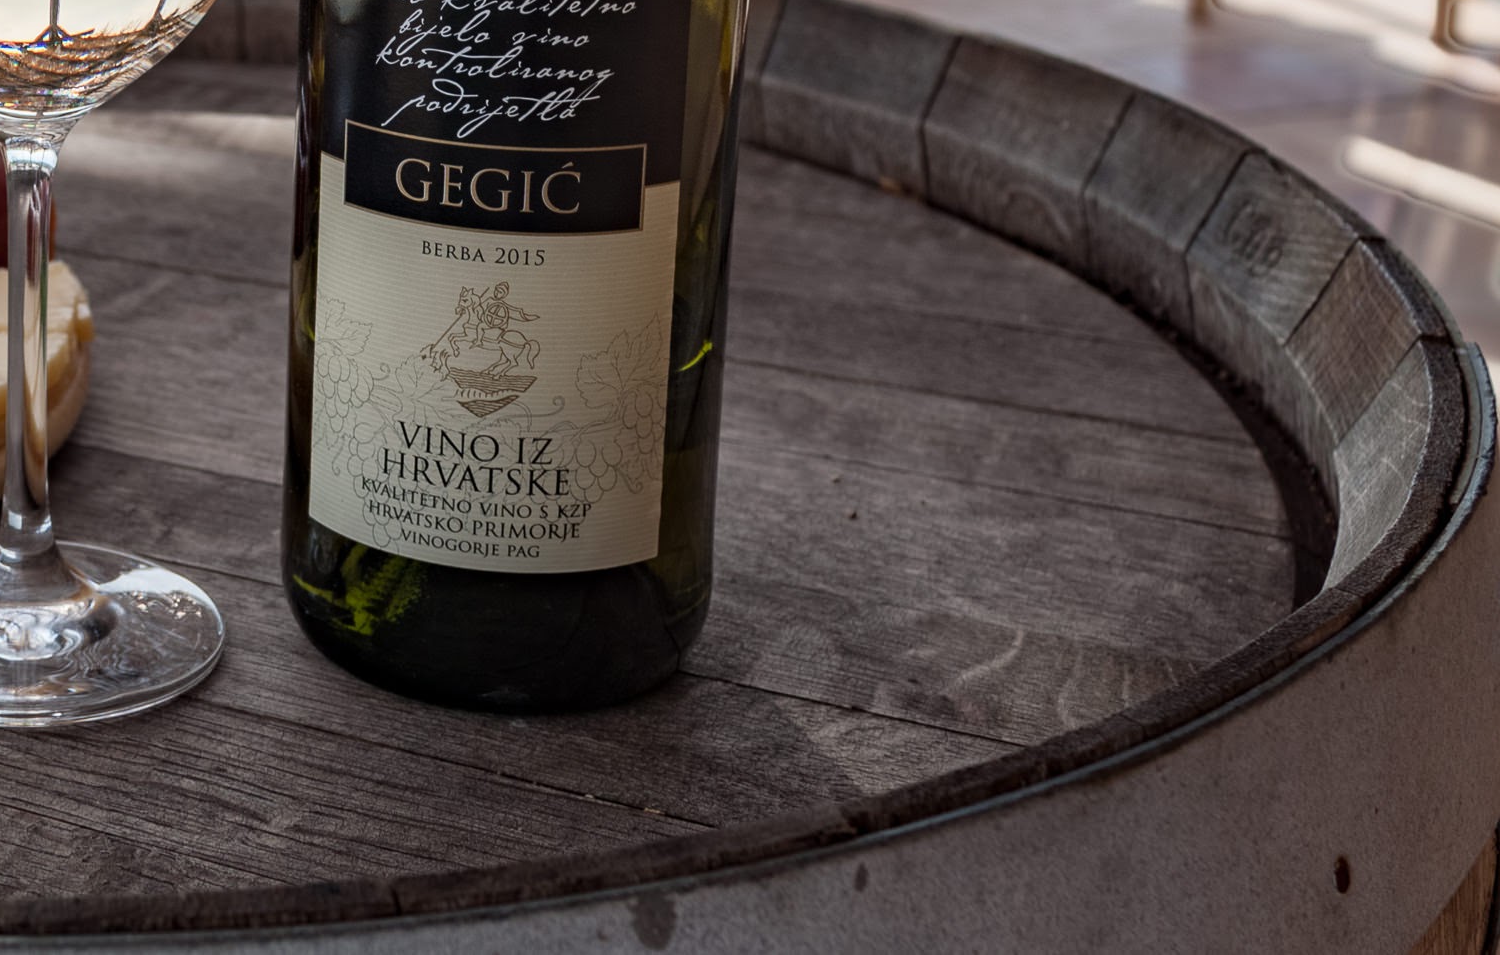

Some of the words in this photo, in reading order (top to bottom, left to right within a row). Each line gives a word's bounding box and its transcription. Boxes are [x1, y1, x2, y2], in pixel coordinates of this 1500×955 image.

[396, 9, 491, 56] bijelo
[512, 28, 591, 47] vino
[375, 36, 615, 106] kontroliranog
[380, 78, 601, 138] podrijetla
[394, 157, 582, 216] GEGIĆ
[421, 240, 486, 264] BERBA
[494, 246, 547, 268] 2015
[398, 420, 500, 464] VINO
[516, 437, 554, 466] IZ
[381, 448, 570, 497] HRVATSKE
[361, 476, 472, 514] KVALITETNO
[479, 502, 533, 519] VINO
[539, 504, 549, 519] S
[556, 503, 593, 519] KZP
[368, 499, 464, 534] HRVATSKO
[472, 519, 581, 543] PRIMORJE
[400, 528, 500, 558] VINOGORJE
[507, 545, 541, 558] PAG
